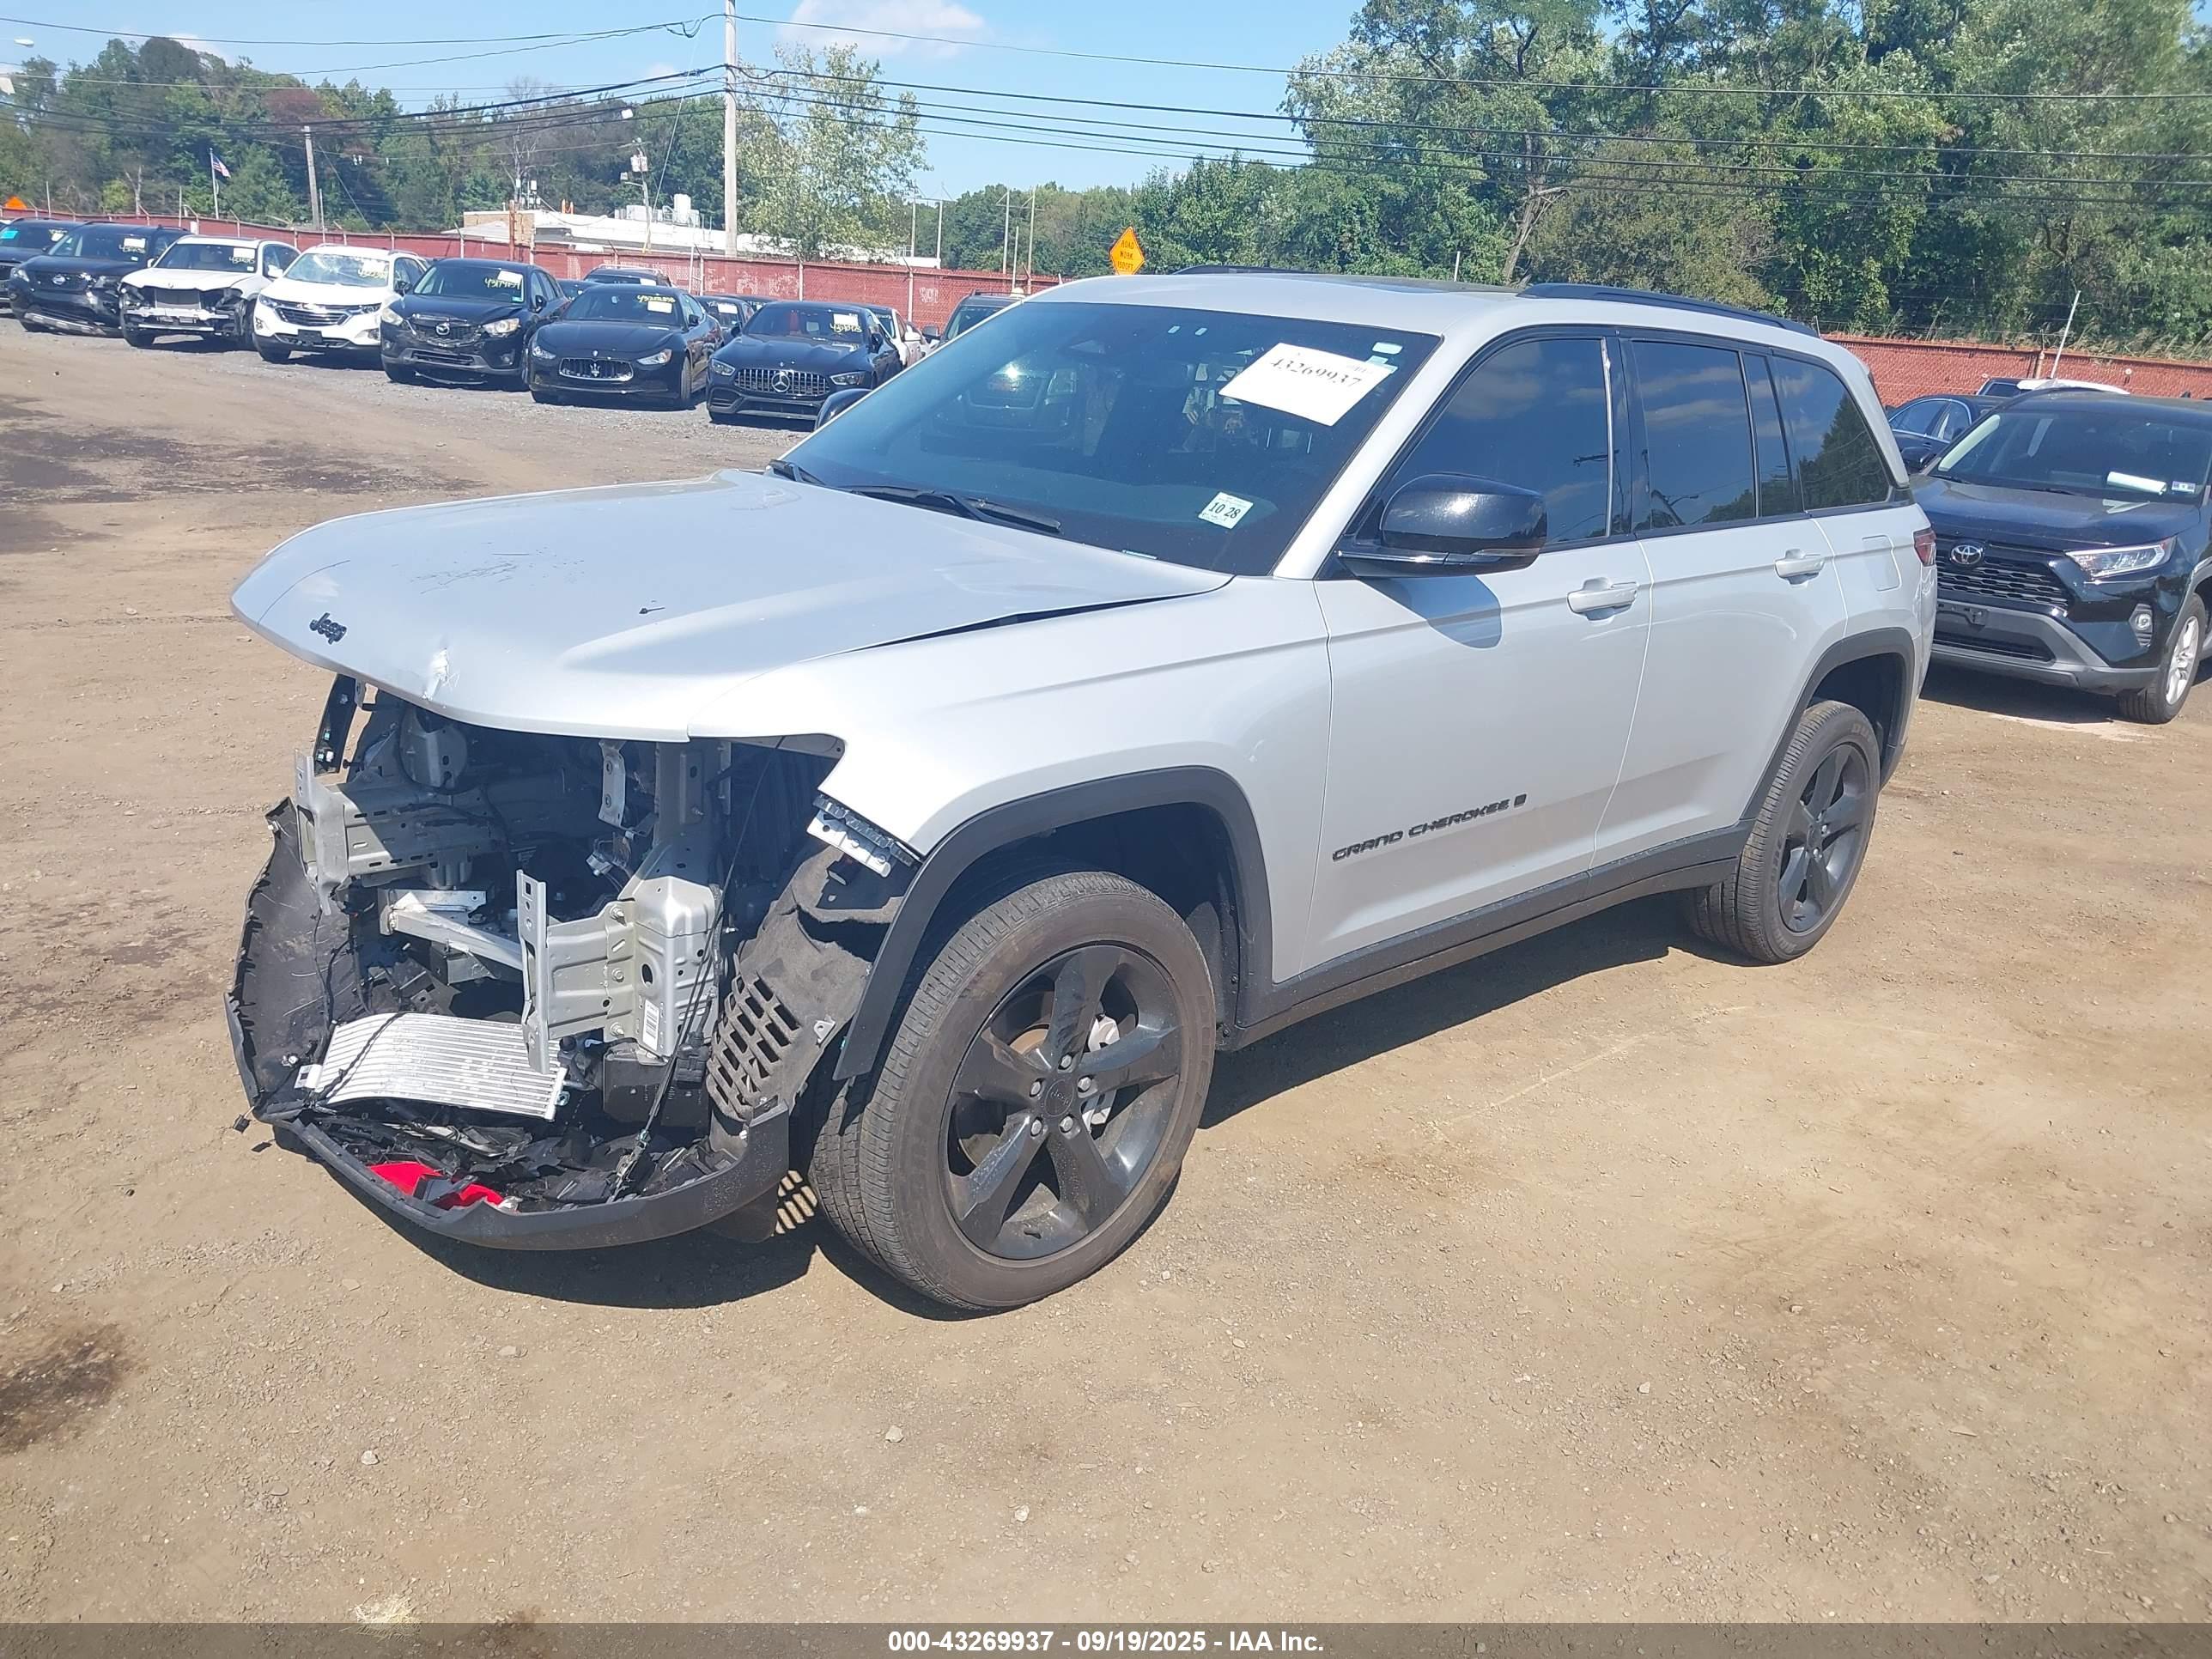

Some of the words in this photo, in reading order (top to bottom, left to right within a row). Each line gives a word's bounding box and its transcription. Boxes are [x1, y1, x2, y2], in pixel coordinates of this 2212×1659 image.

[1271, 358, 1362, 387] 43269937
[1208, 501, 1226, 514] 10
[1224, 507, 1242, 519] 28
[309, 612, 347, 645] Jeep
[1332, 830, 1404, 862] GRAND
[1408, 799, 1510, 838] CHEROKEE
